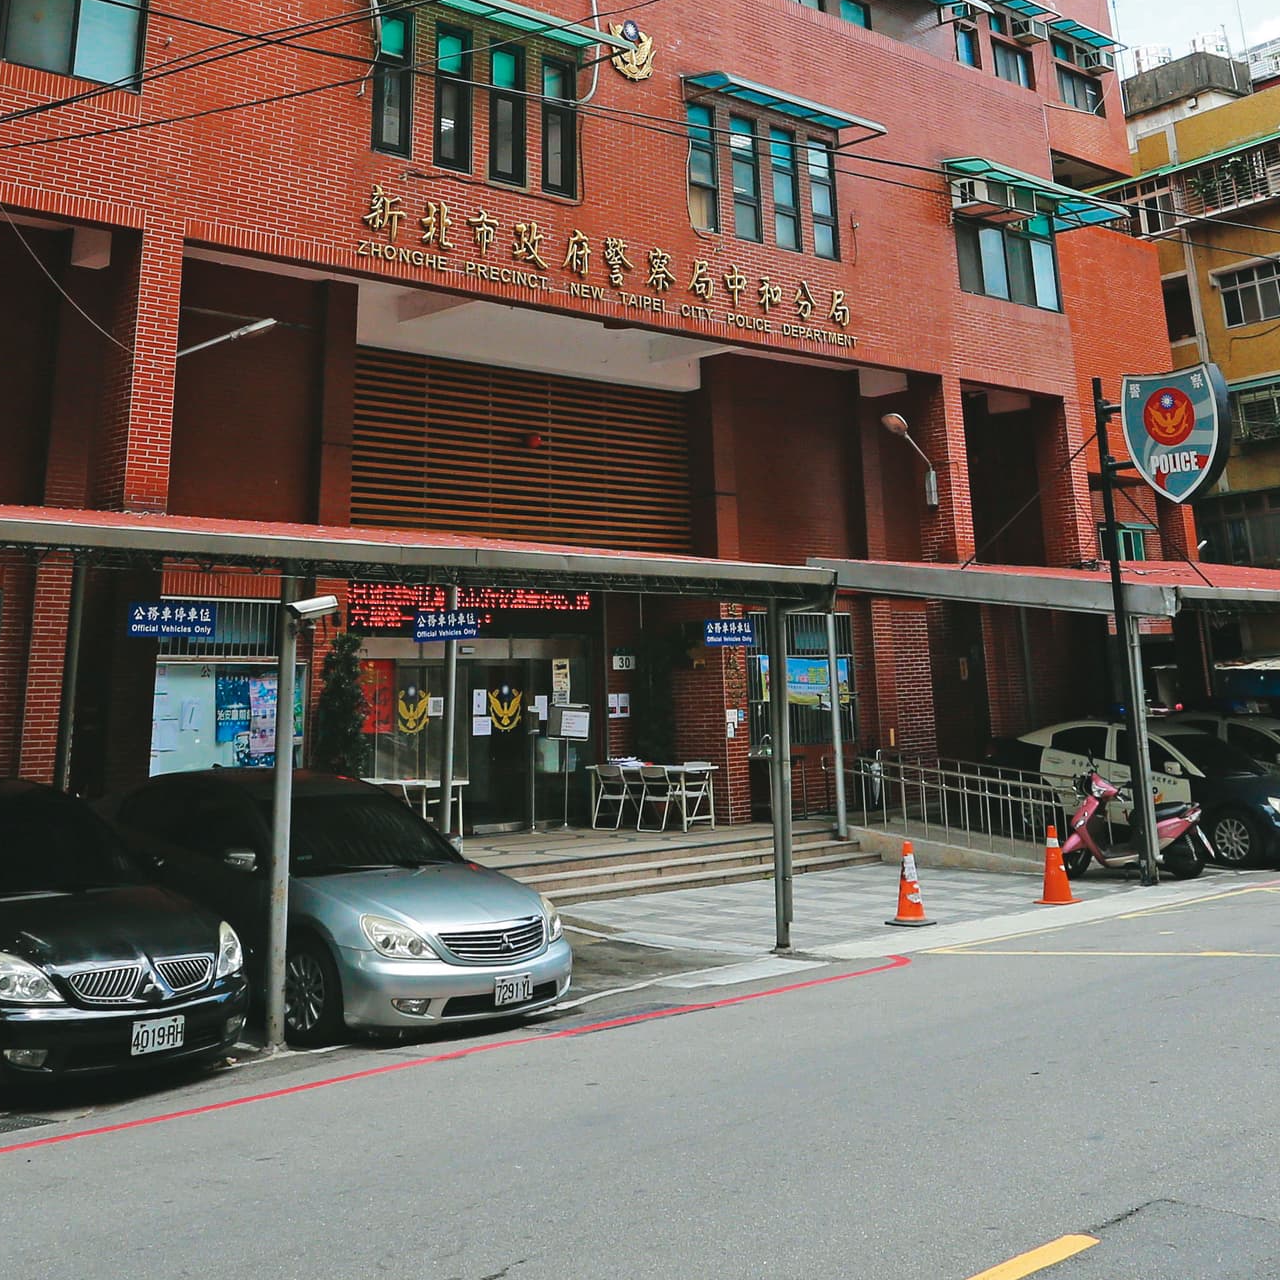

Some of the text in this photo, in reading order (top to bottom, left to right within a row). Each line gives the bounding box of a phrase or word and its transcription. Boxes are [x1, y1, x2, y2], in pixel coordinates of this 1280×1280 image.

[362, 184, 851, 329] 新北市政府警察局中和分局
[357, 240, 448, 271] ZHONGHE
[570, 282, 605, 300] NEW
[619, 291, 666, 313] TAIPEI
[681, 304, 714, 320] CITY
[727, 312, 771, 333] POLICE
[782, 324, 859, 349] DEPARTMENT
[1150, 451, 1199, 475] POLICE
[133, 606, 212, 623] 公務車停車位
[417, 612, 476, 628] 公務車停車位
[131, 624, 211, 635] Official Vehicles Only
[416, 628, 476, 638] Official Vehicles Only
[618, 657, 631, 669] 30
